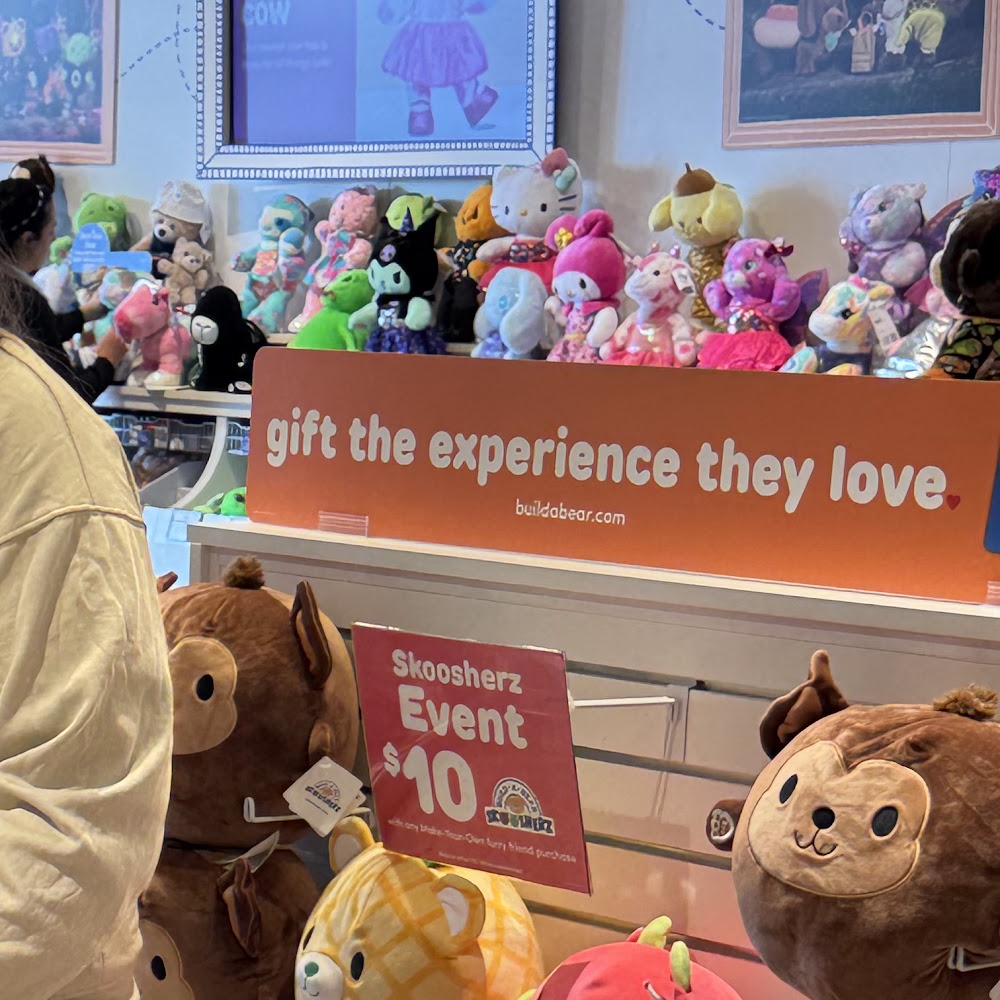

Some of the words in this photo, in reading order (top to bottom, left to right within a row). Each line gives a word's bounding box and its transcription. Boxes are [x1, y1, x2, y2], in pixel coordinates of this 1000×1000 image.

[266, 406, 338, 467] gift
[349, 413, 417, 465] the
[428, 424, 681, 487] experience
[696, 437, 815, 514] they
[829, 444, 947, 510] love
[515, 498, 627, 526] buildabear.com
[391, 648, 523, 695] Skoosherz
[397, 683, 528, 750] Event
[382, 741, 478, 823] $10
